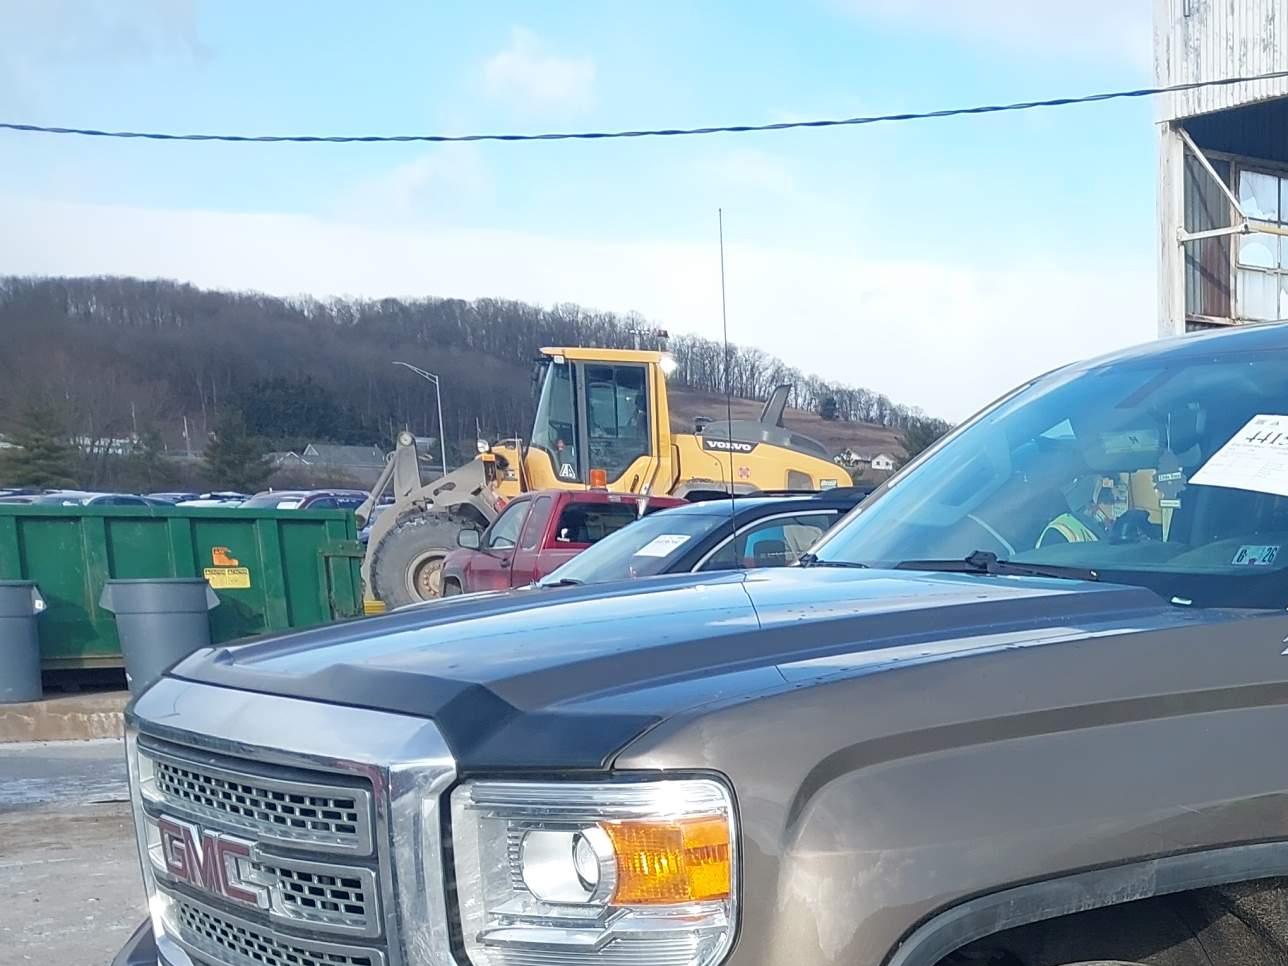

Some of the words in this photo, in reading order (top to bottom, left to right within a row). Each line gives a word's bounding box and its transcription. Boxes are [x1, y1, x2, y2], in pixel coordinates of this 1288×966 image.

[706, 440, 752, 451] VOLVO
[1262, 547, 1278, 563] 26
[158, 814, 272, 909] GMC
